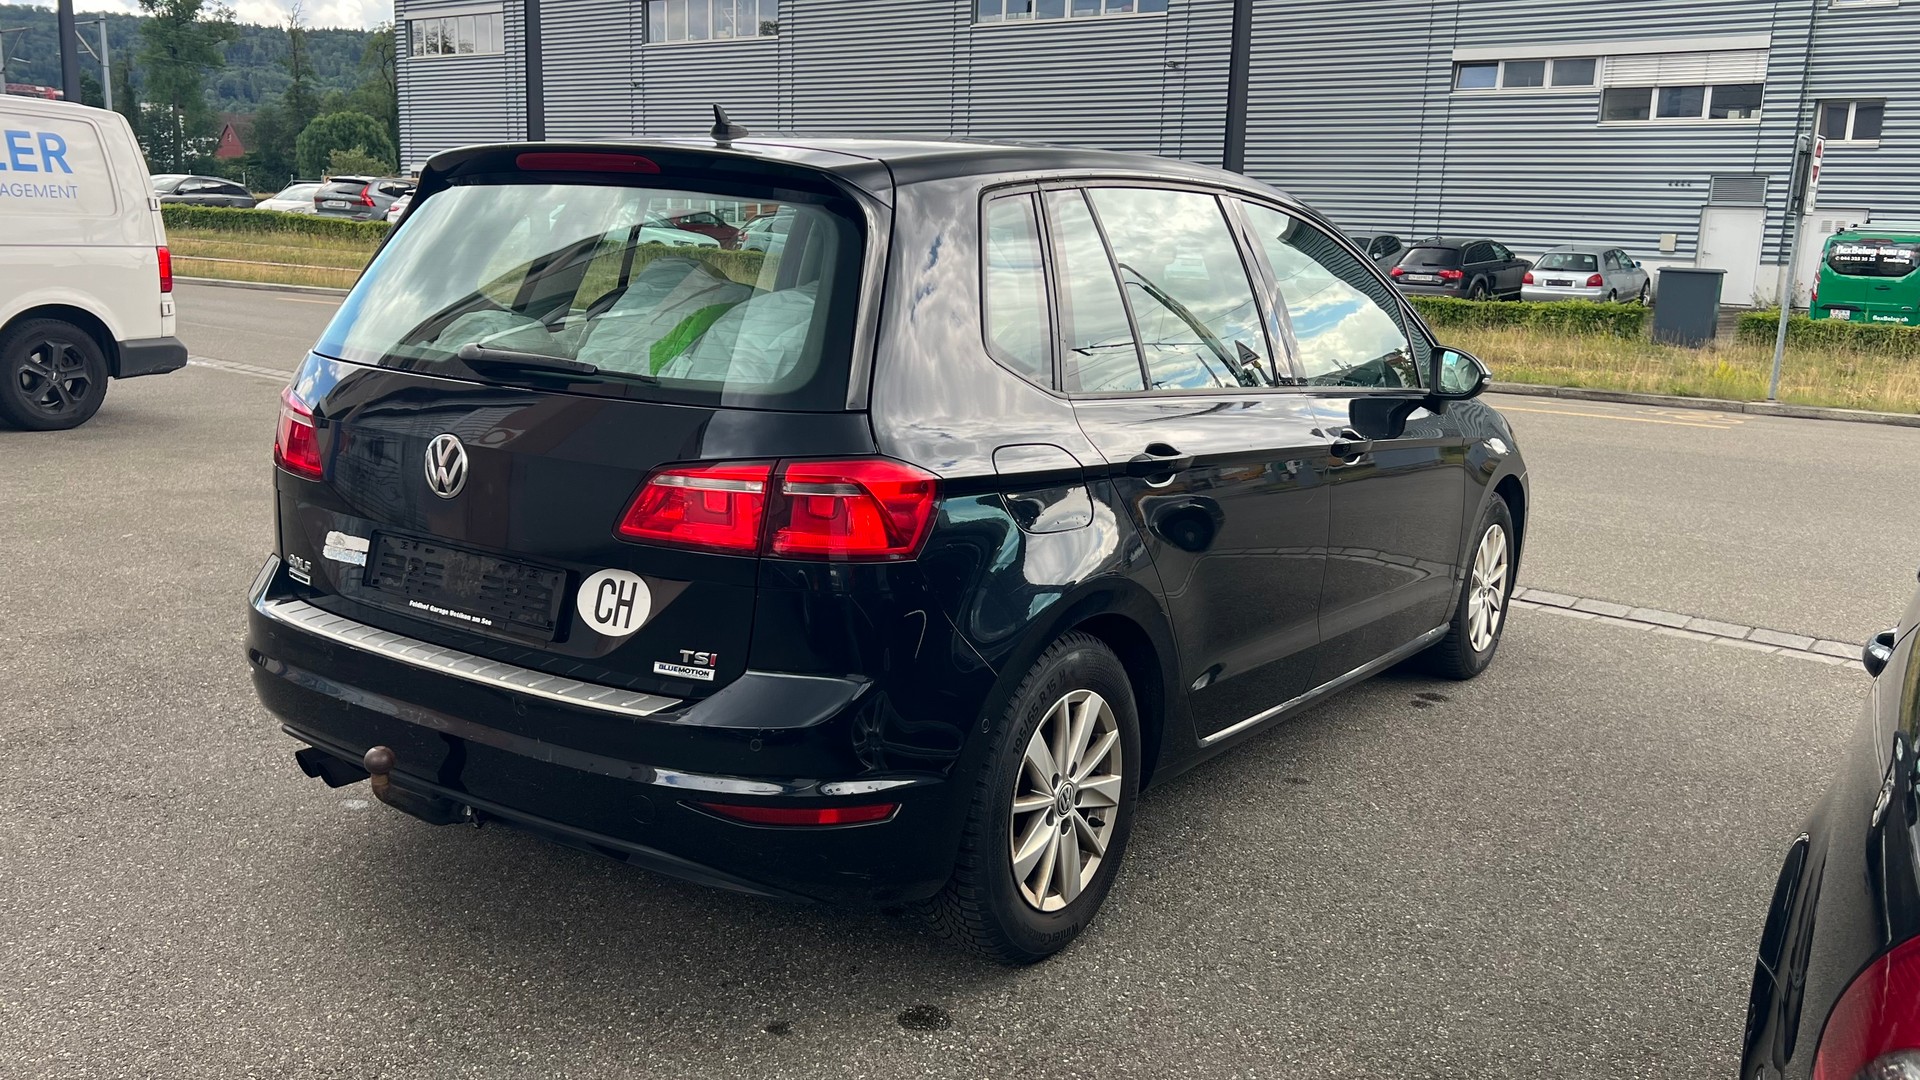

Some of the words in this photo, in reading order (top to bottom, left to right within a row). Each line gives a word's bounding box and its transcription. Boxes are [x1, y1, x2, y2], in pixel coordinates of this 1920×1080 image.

[288, 553, 312, 573] GOLF
[594, 578, 638, 629] CH
[429, 605, 449, 615] Garage
[481, 618, 492, 626] See
[680, 649, 718, 667] TSI
[658, 663, 710, 677] BLUEMOTION
